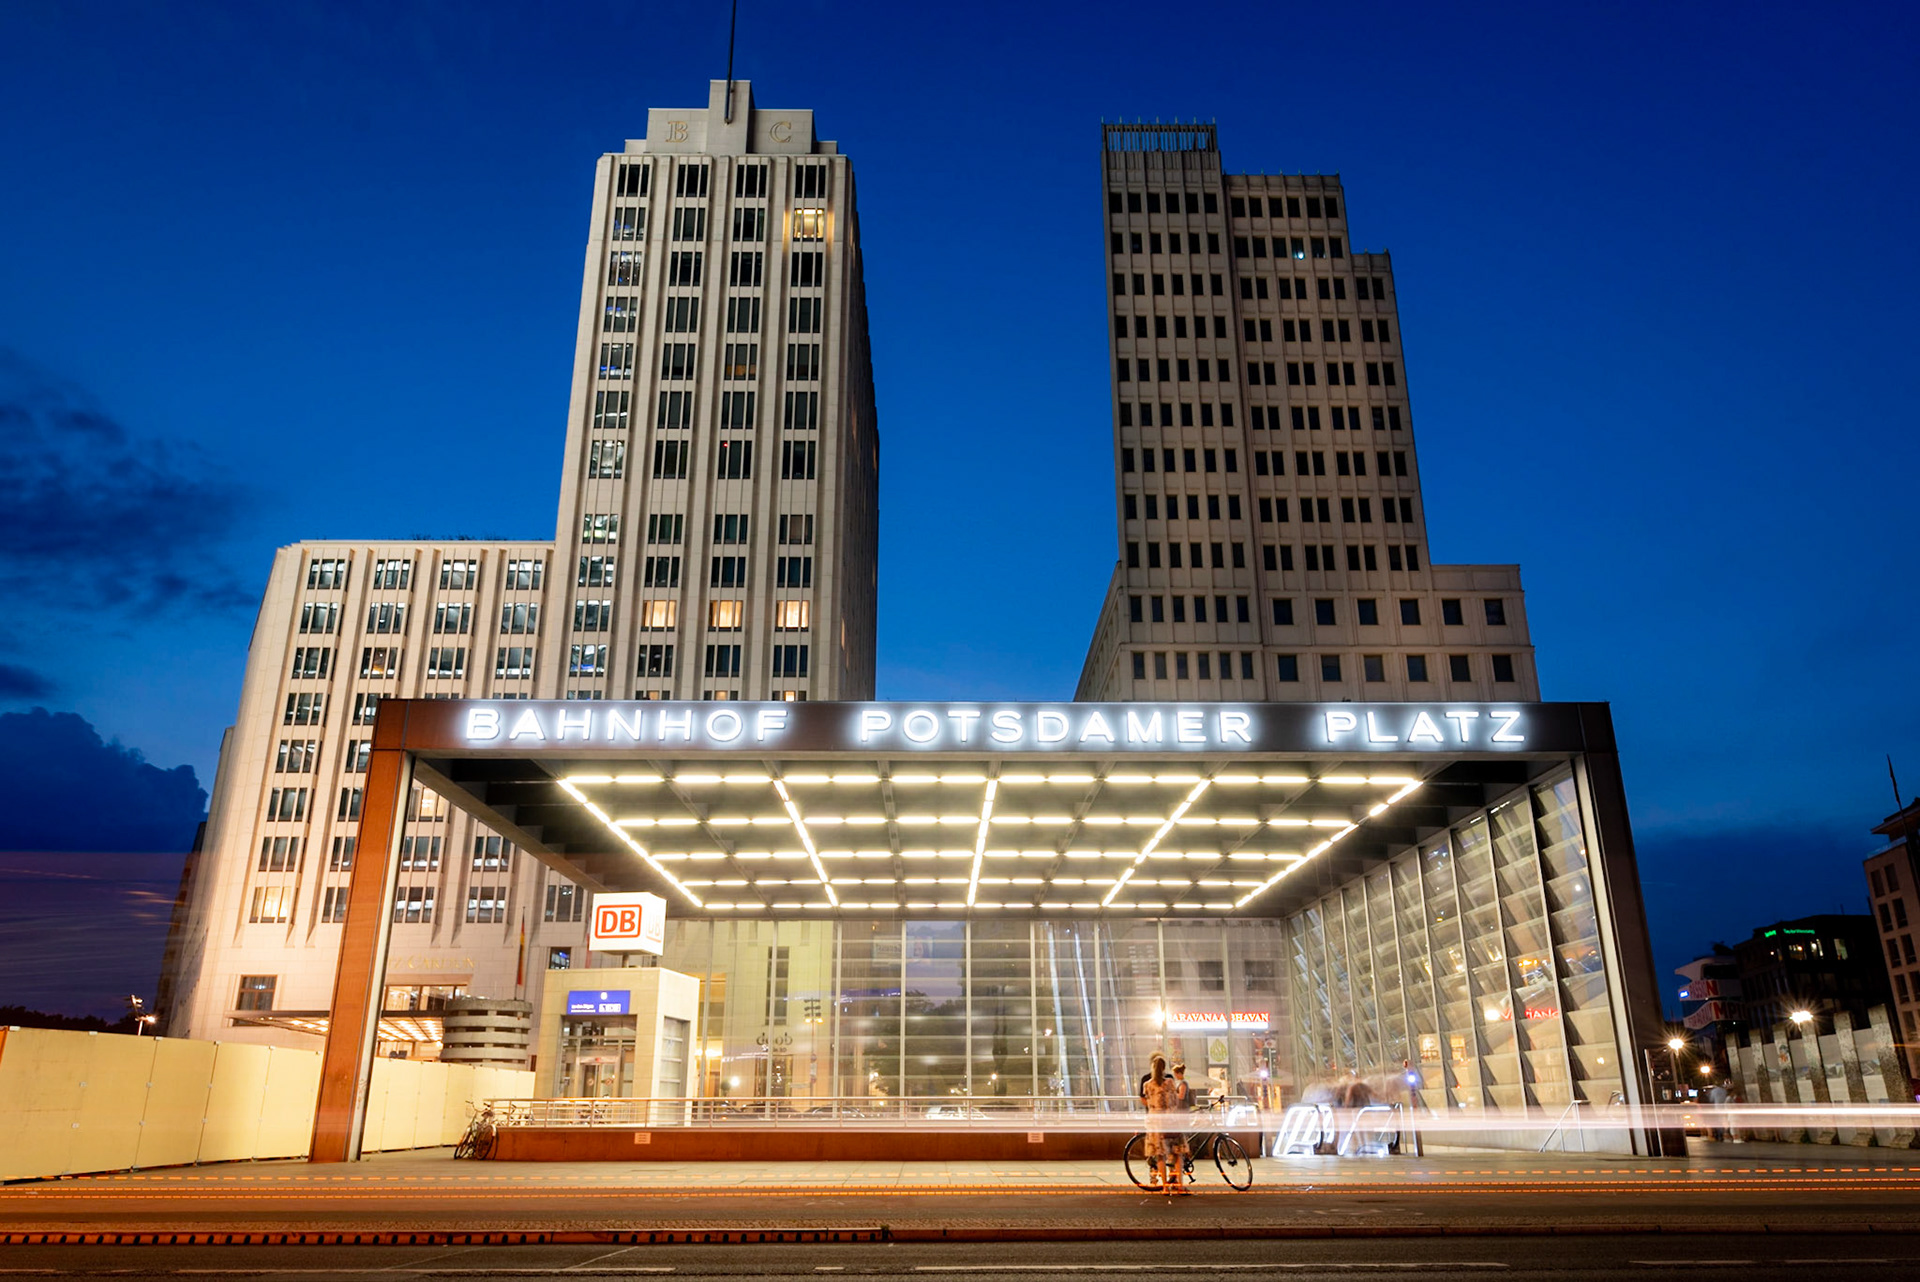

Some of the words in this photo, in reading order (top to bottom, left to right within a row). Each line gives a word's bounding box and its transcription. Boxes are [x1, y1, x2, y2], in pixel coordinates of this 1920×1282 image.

[665, 121, 688, 143] B
[770, 121, 792, 143] C
[466, 708, 788, 741] BAHNHOF
[860, 709, 1252, 743] POTSDAMER
[1325, 711, 1525, 742] PLATZ
[600, 910, 636, 933] DB
